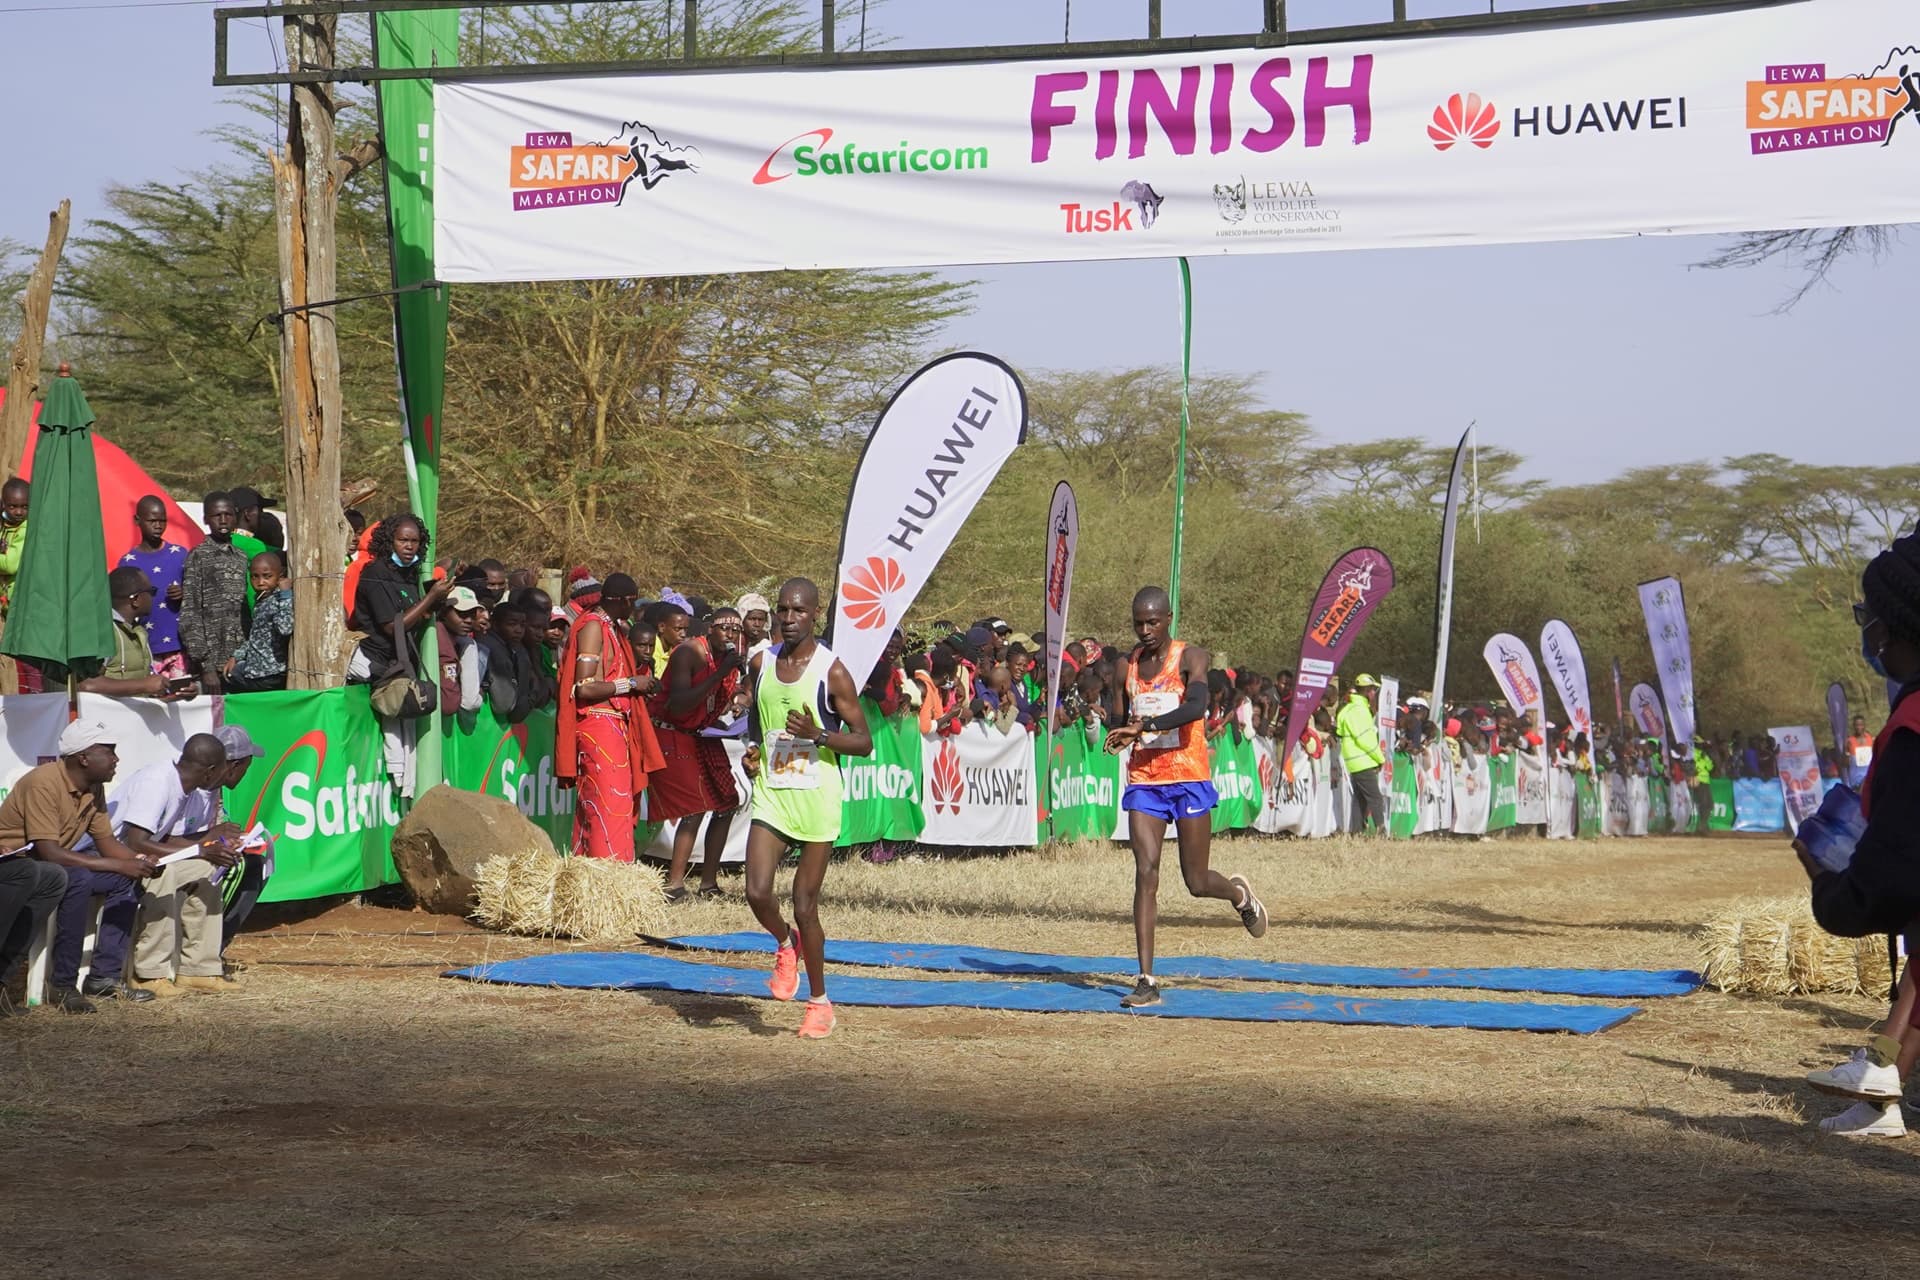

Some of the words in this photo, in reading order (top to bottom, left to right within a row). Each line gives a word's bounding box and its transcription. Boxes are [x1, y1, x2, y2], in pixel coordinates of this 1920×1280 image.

[1771, 67, 1820, 81] LEWA
[1030, 53, 1374, 164] FINISH
[1514, 96, 1687, 138] HUAWEI
[1758, 87, 1886, 121] SAFARI
[529, 133, 569, 146] LEWA
[1759, 124, 1883, 150] MARATHON
[519, 154, 620, 182] SAFARI
[793, 140, 989, 176] Safaricom
[519, 186, 616, 207] MARATHON
[1251, 181, 1315, 199] LEWA
[1060, 201, 1133, 233] Tusk
[1254, 199, 1318, 212] WILDLIFE
[1254, 209, 1341, 223] CONSERVANCY
[887, 386, 999, 552] HUAWEI
[1318, 591, 1357, 640] SAFARI
[1329, 600, 1363, 647] MARATHON
[773, 751, 810, 775] 647
[965, 766, 1028, 806] HUAWEI
